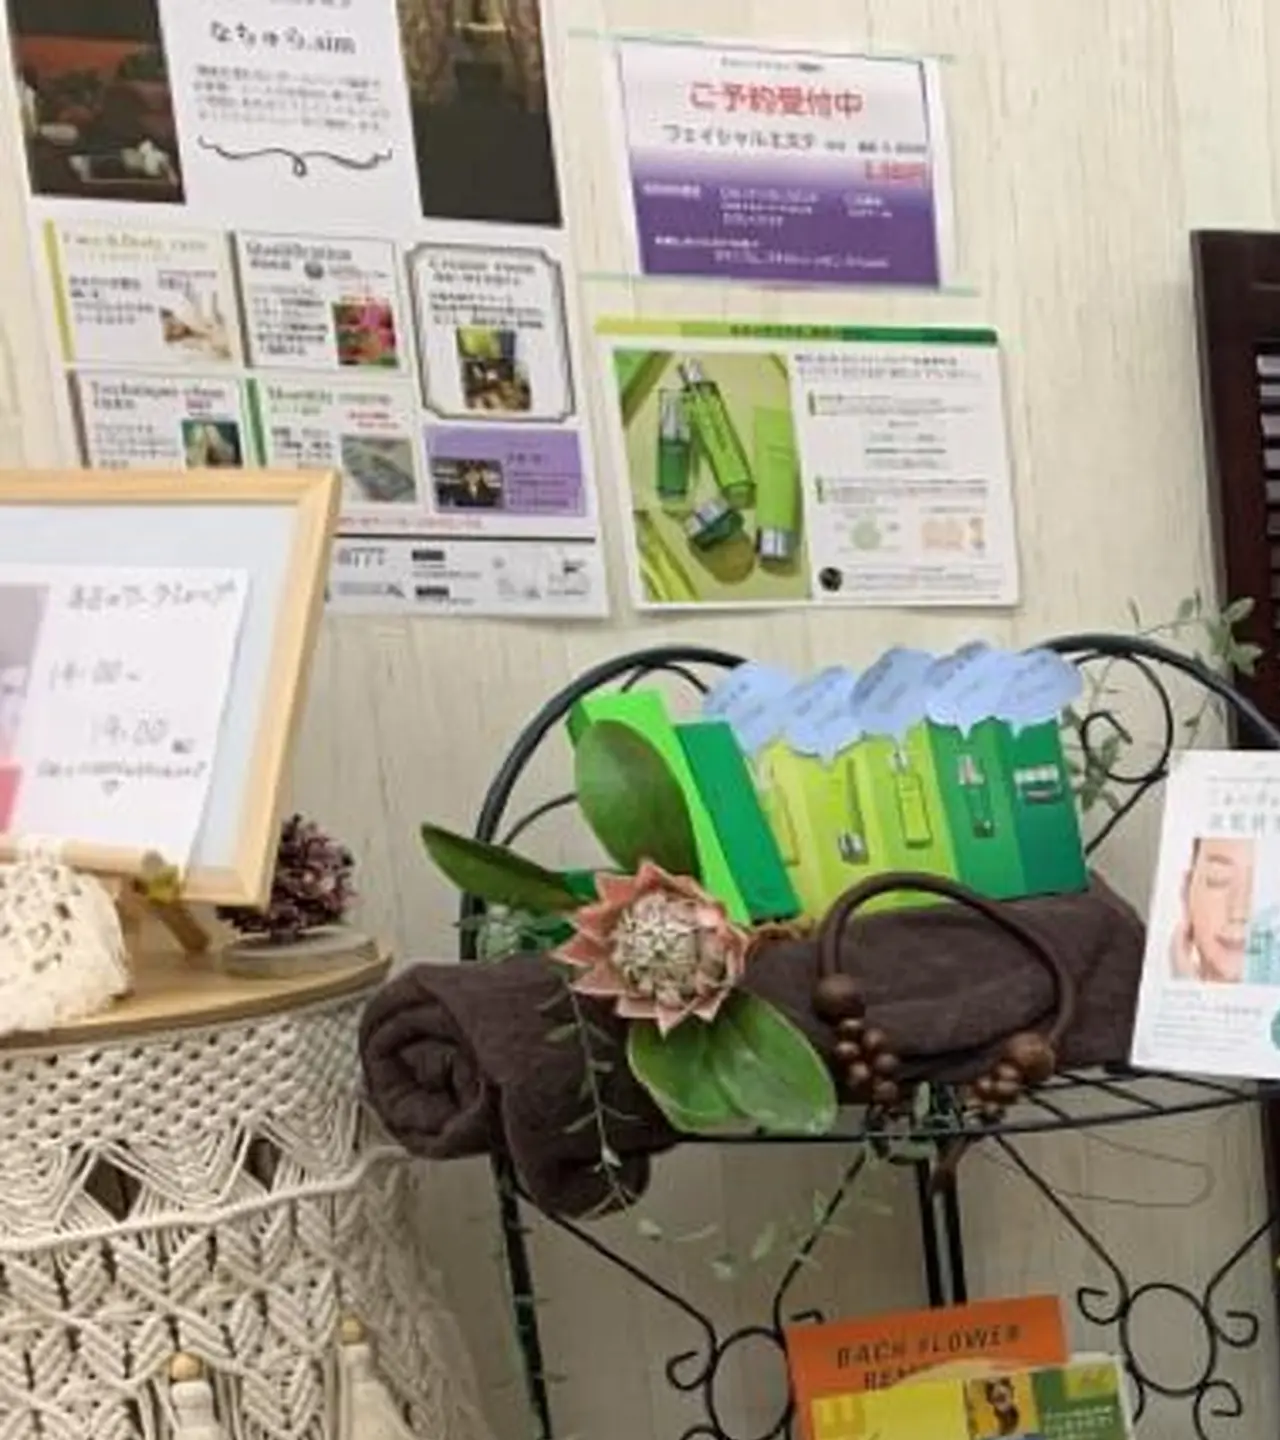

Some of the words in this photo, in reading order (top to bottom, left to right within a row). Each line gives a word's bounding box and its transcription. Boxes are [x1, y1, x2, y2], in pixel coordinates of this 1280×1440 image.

[690, 83, 864, 119] ご予約受付中
[919, 1322, 1020, 1354] FLOWER
